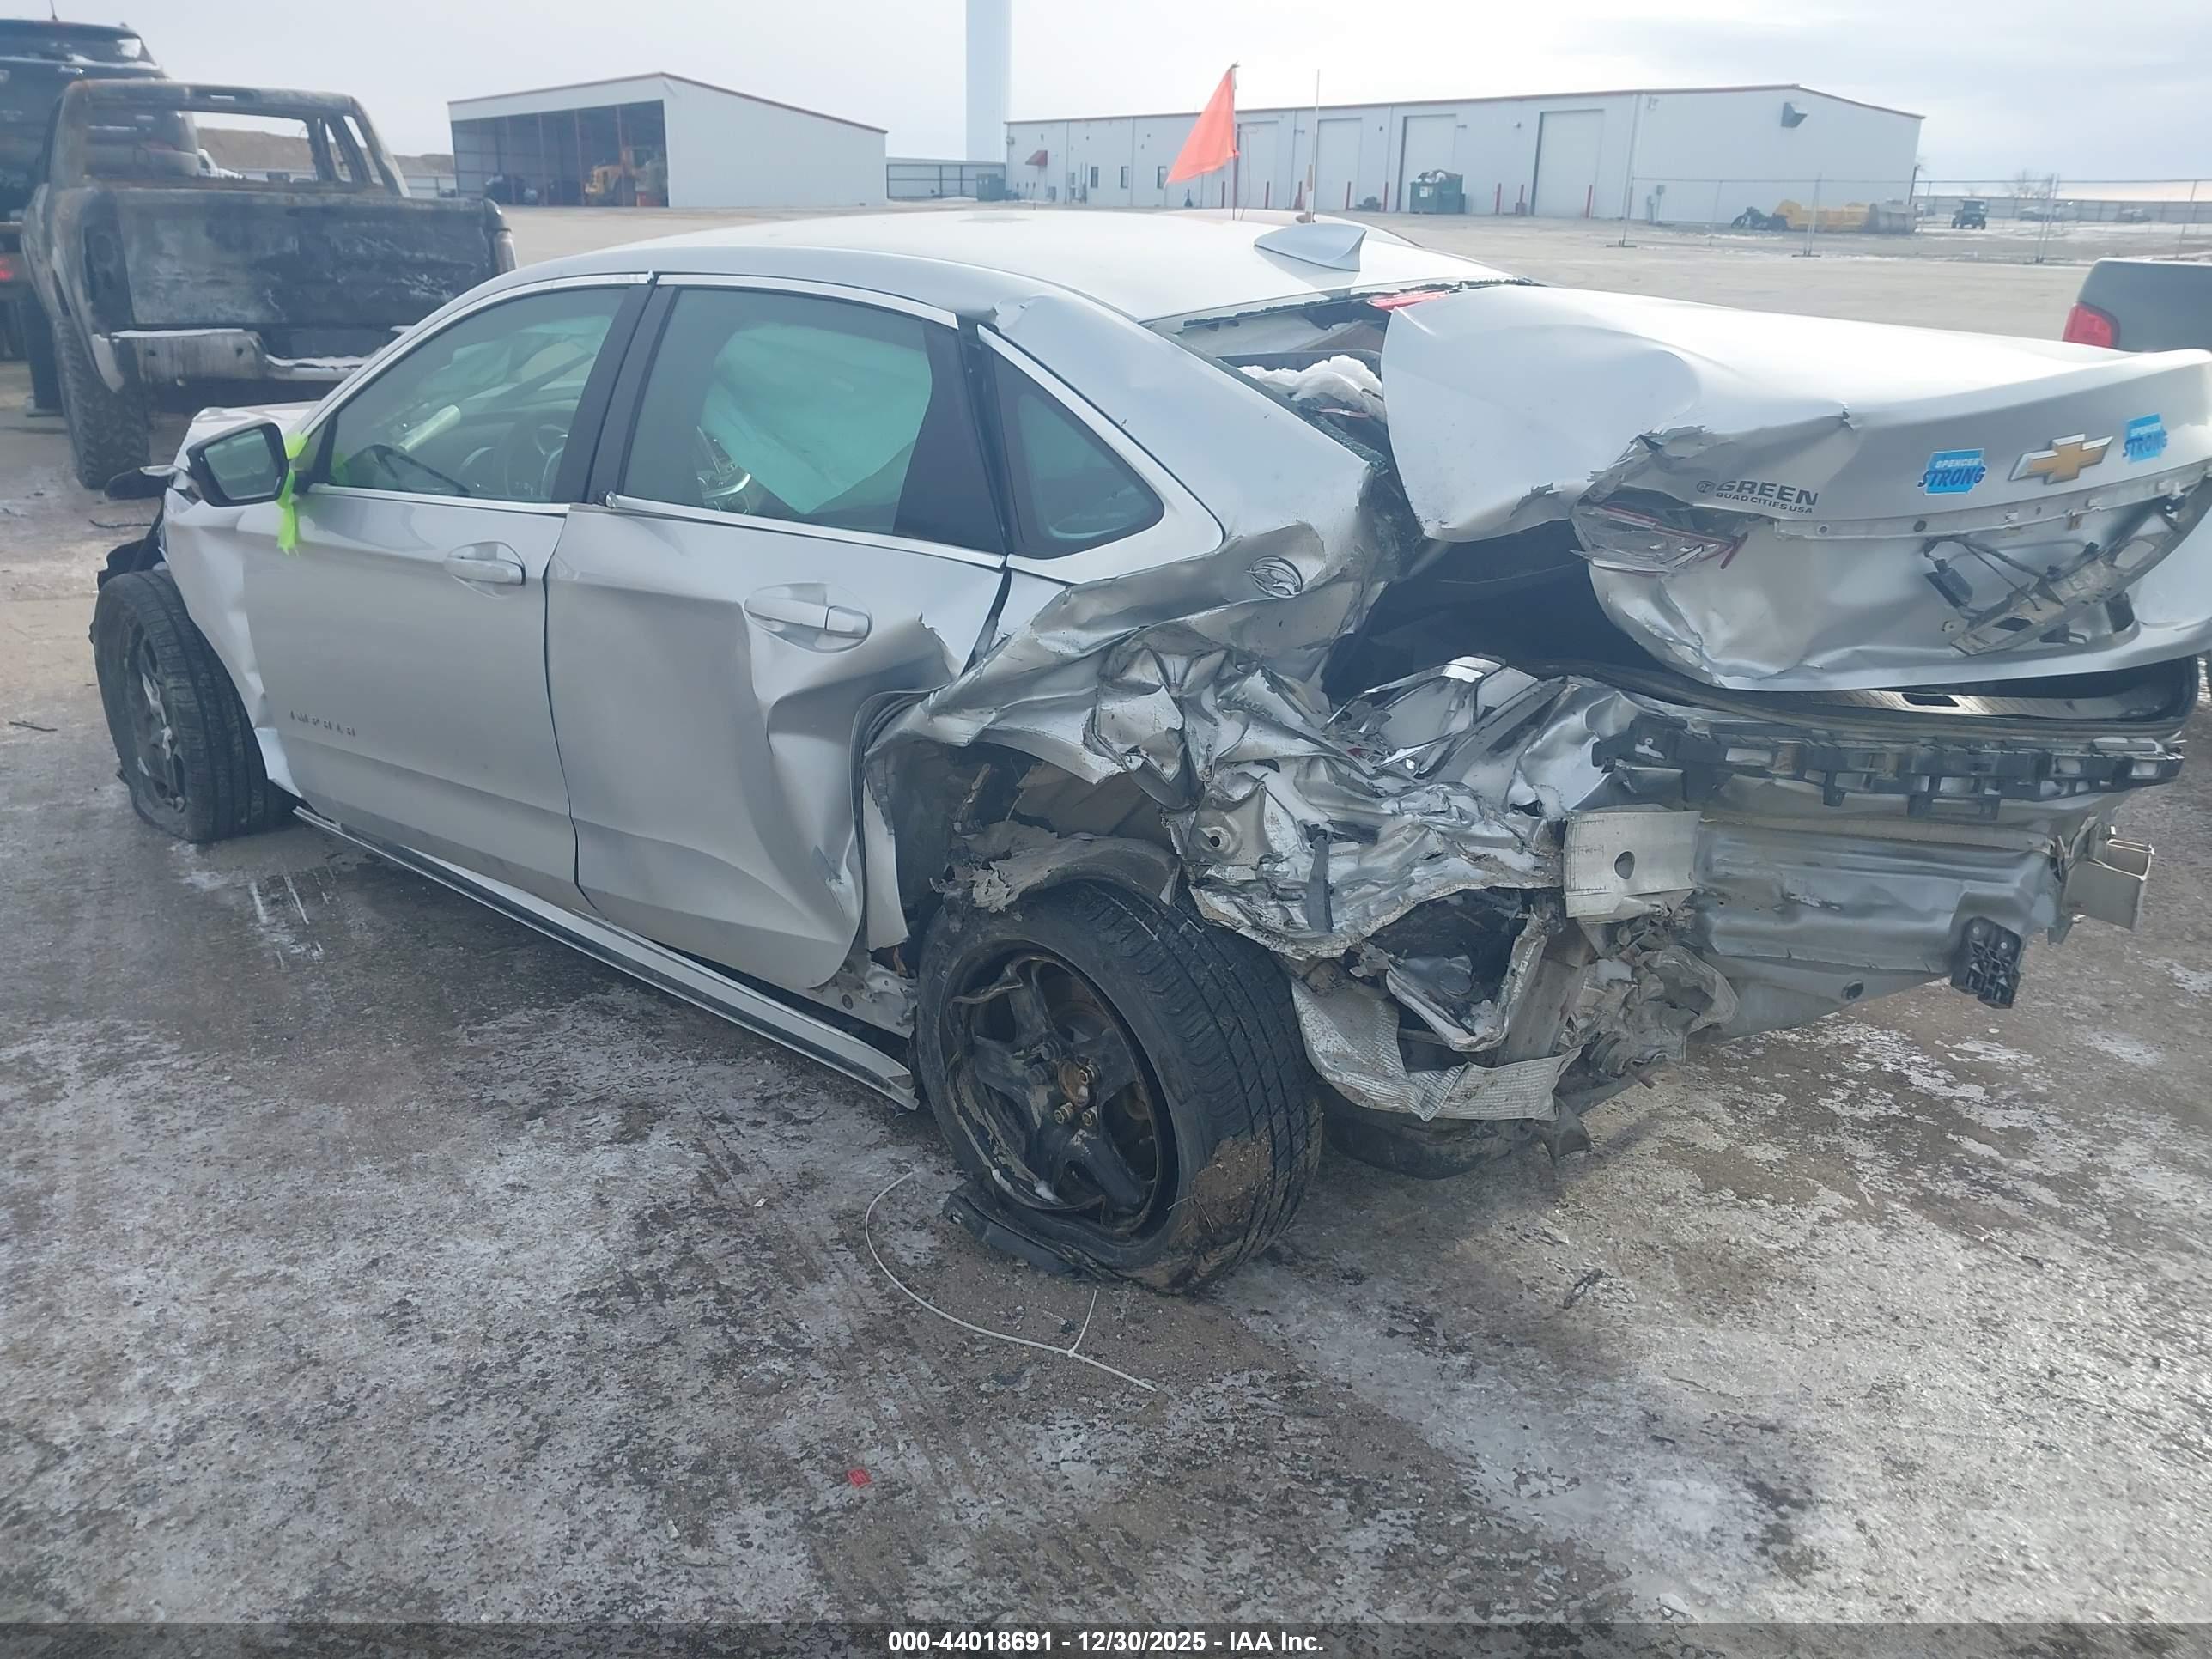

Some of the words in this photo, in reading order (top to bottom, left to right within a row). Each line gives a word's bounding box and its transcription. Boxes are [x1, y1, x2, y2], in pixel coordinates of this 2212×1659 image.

[1917, 467, 1986, 488] STRONG
[1716, 480, 1819, 506] GREEN
[1716, 492, 1748, 501] QUAD
[1750, 496, 1788, 510] CITIES
[1789, 505, 1813, 514] USA
